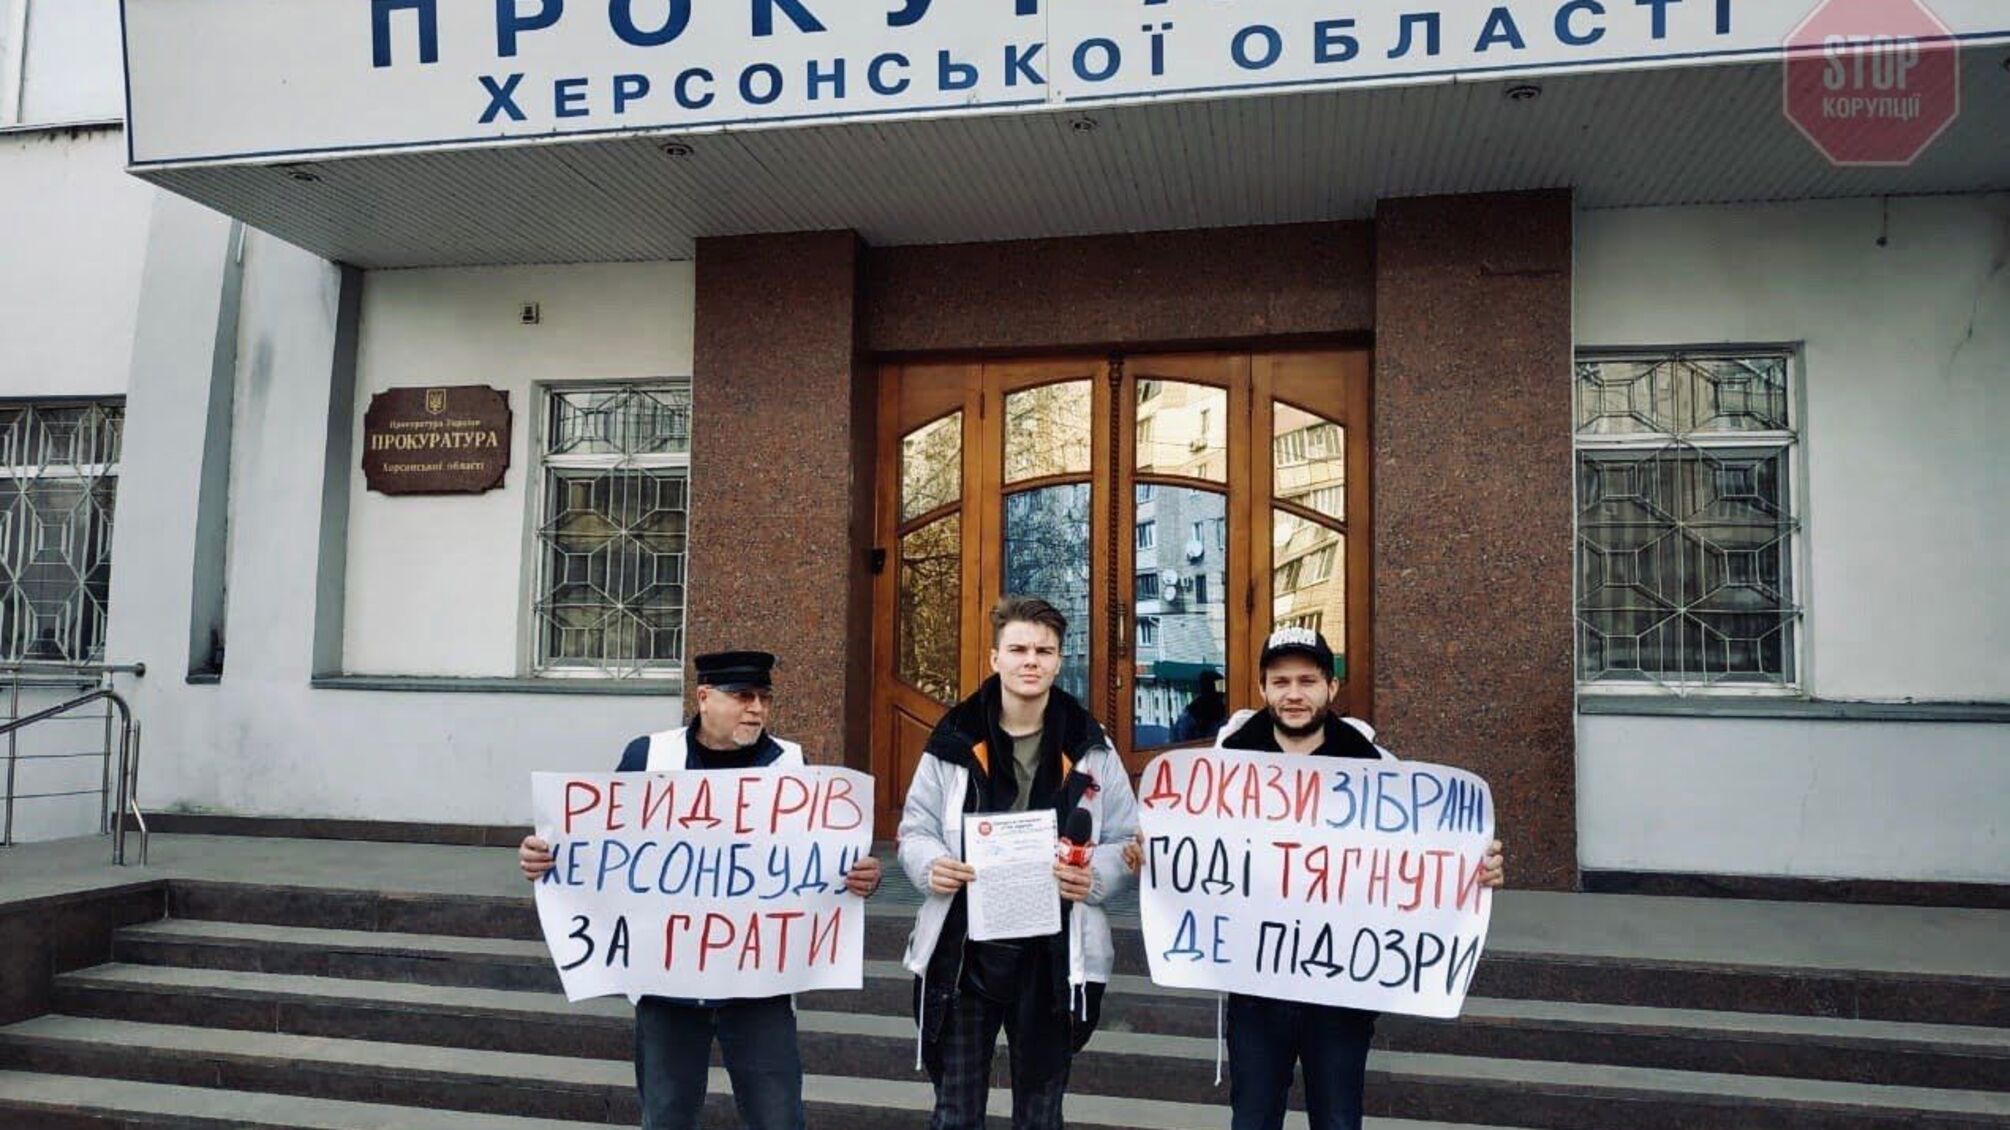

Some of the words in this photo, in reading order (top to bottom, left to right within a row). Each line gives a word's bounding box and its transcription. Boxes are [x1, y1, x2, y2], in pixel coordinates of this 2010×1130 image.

[478, 22, 1173, 124] ХЕРСОНСЬКОЇ
[1230, 0, 1730, 70] ОБЛАСТІ
[371, 431, 498, 450] ПРОКУРАТУРА
[564, 771, 863, 835] РЕЙДЕРІВ
[1144, 757, 1320, 828] ДОКАЗИ
[1326, 767, 1483, 835] ЗІБРАНІ
[1272, 841, 1484, 914] ТЯГНУТИ
[561, 914, 630, 971] ЗА
[664, 906, 842, 973] ГРАТИ
[1163, 909, 1231, 963] ДЕ
[1256, 919, 1479, 995] ПІДОЗРИ
